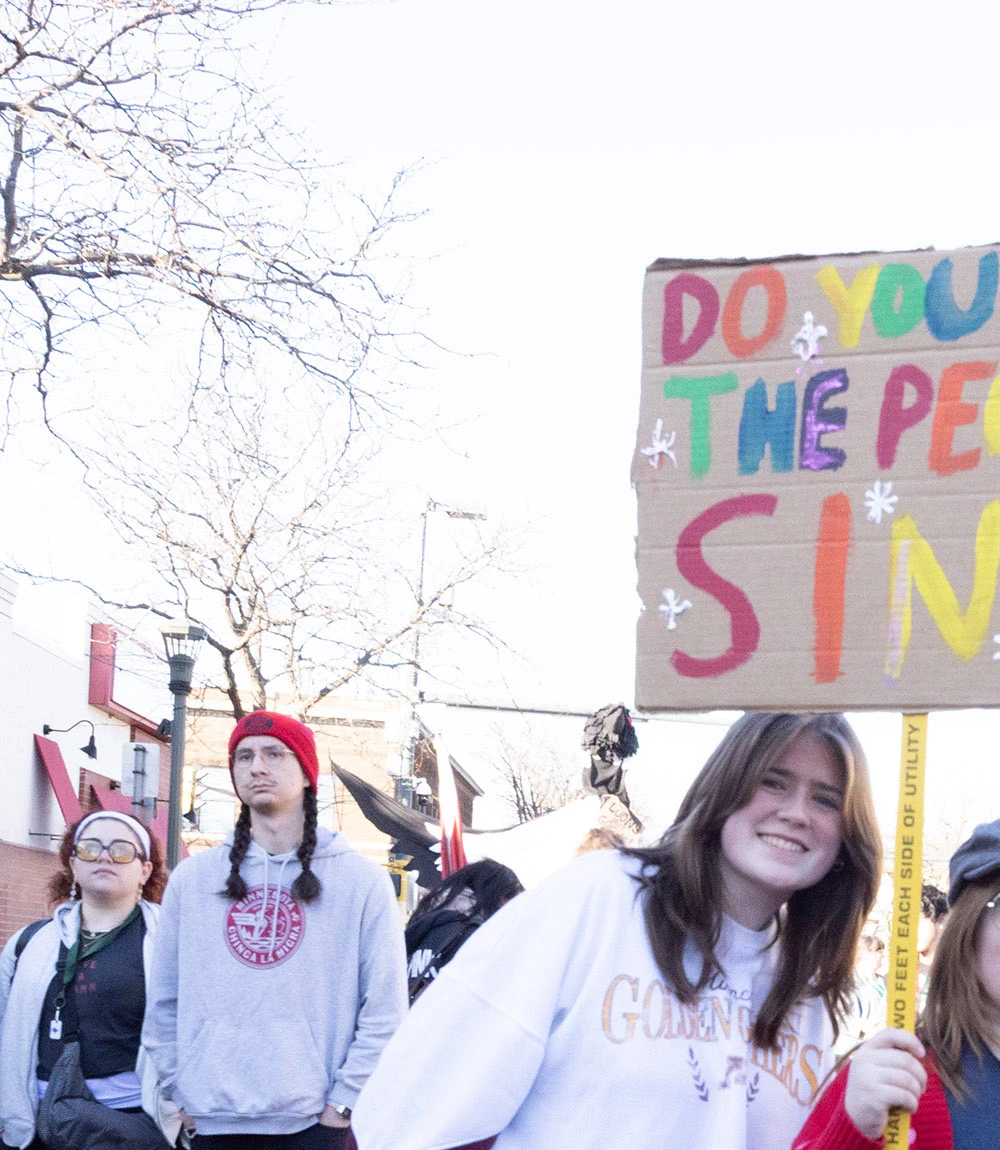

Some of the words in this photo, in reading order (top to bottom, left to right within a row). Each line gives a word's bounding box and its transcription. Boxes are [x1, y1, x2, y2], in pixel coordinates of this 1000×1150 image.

[662, 265, 787, 364] DO
[814, 250, 1000, 349] YOU
[663, 368, 849, 479] THE
[905, 724, 920, 796] UTILITY
[903, 804, 916, 827] OF
[901, 836, 914, 879] SIDE
[898, 887, 911, 938] EACH
[895, 946, 909, 991] FEET
[894, 999, 906, 1028] WO
